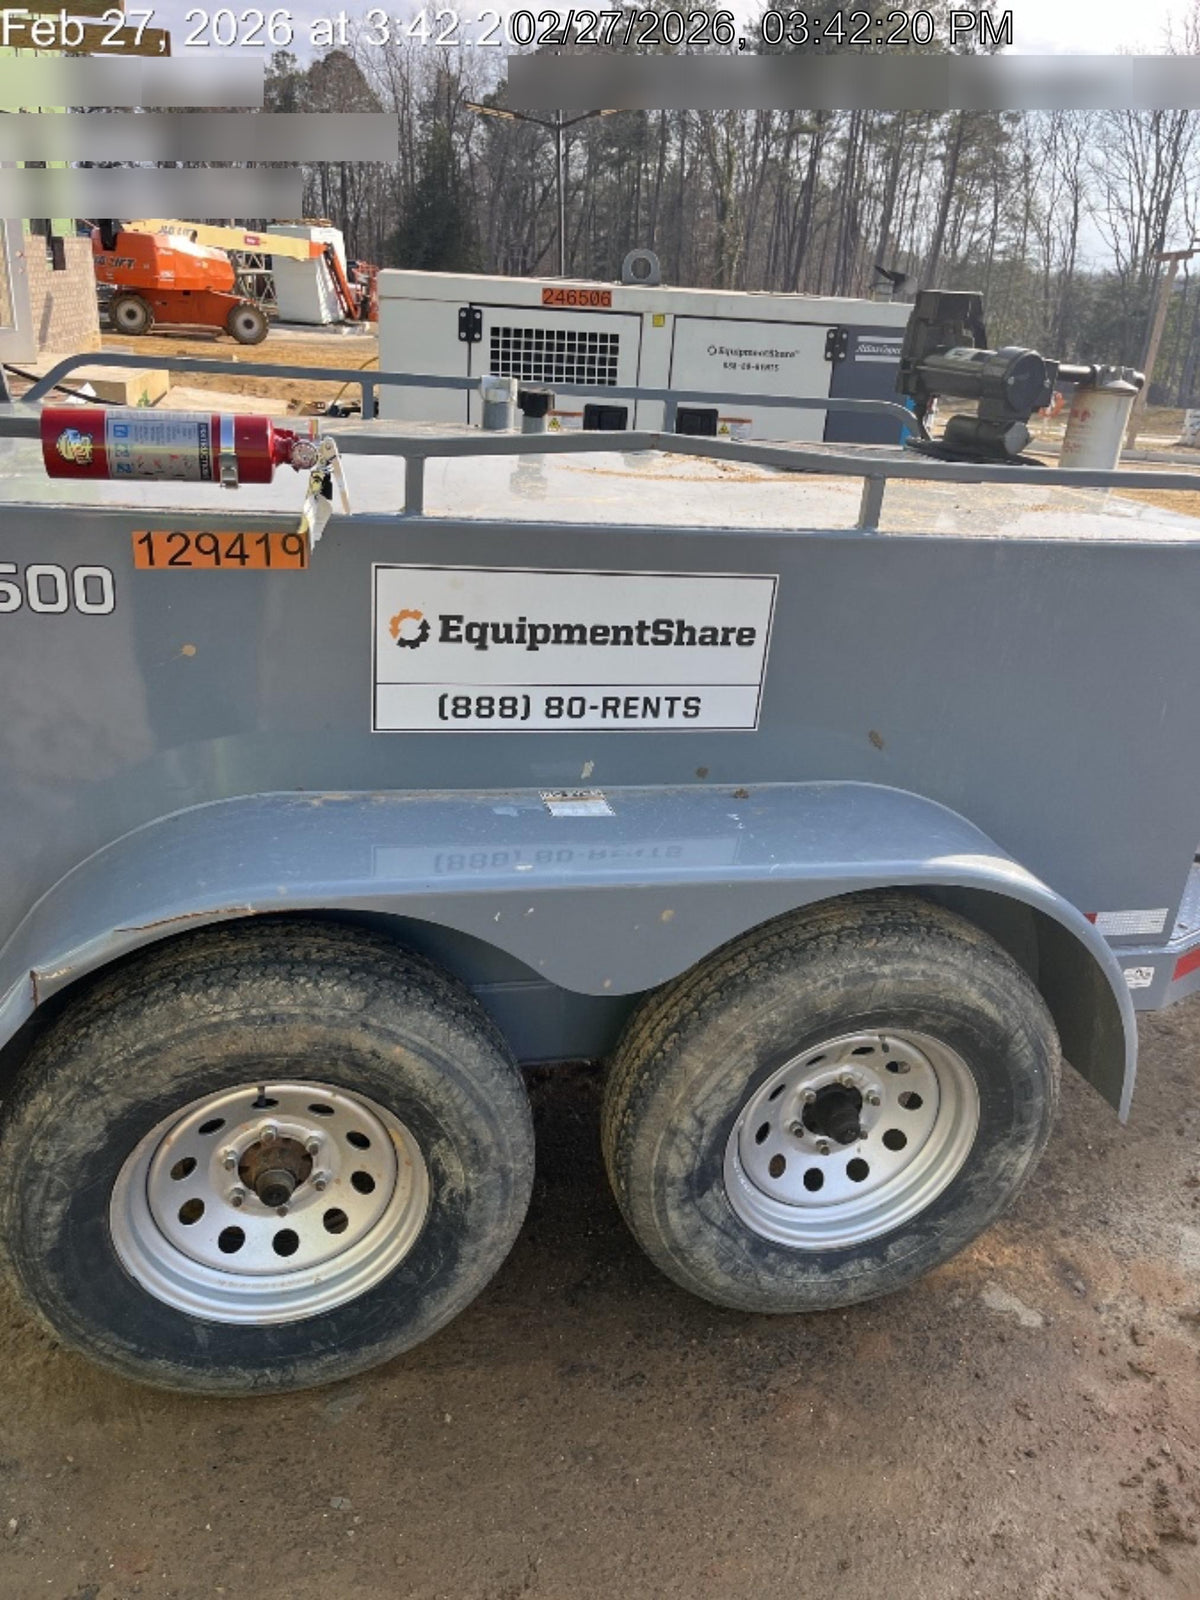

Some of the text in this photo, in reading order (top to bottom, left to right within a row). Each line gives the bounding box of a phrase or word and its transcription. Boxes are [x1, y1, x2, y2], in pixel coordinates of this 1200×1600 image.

[543, 288, 611, 307] 246506
[137, 531, 305, 568] 129419
[438, 614, 757, 651] EquipmentShare
[438, 693, 702, 720] (888) 80-RENTS
